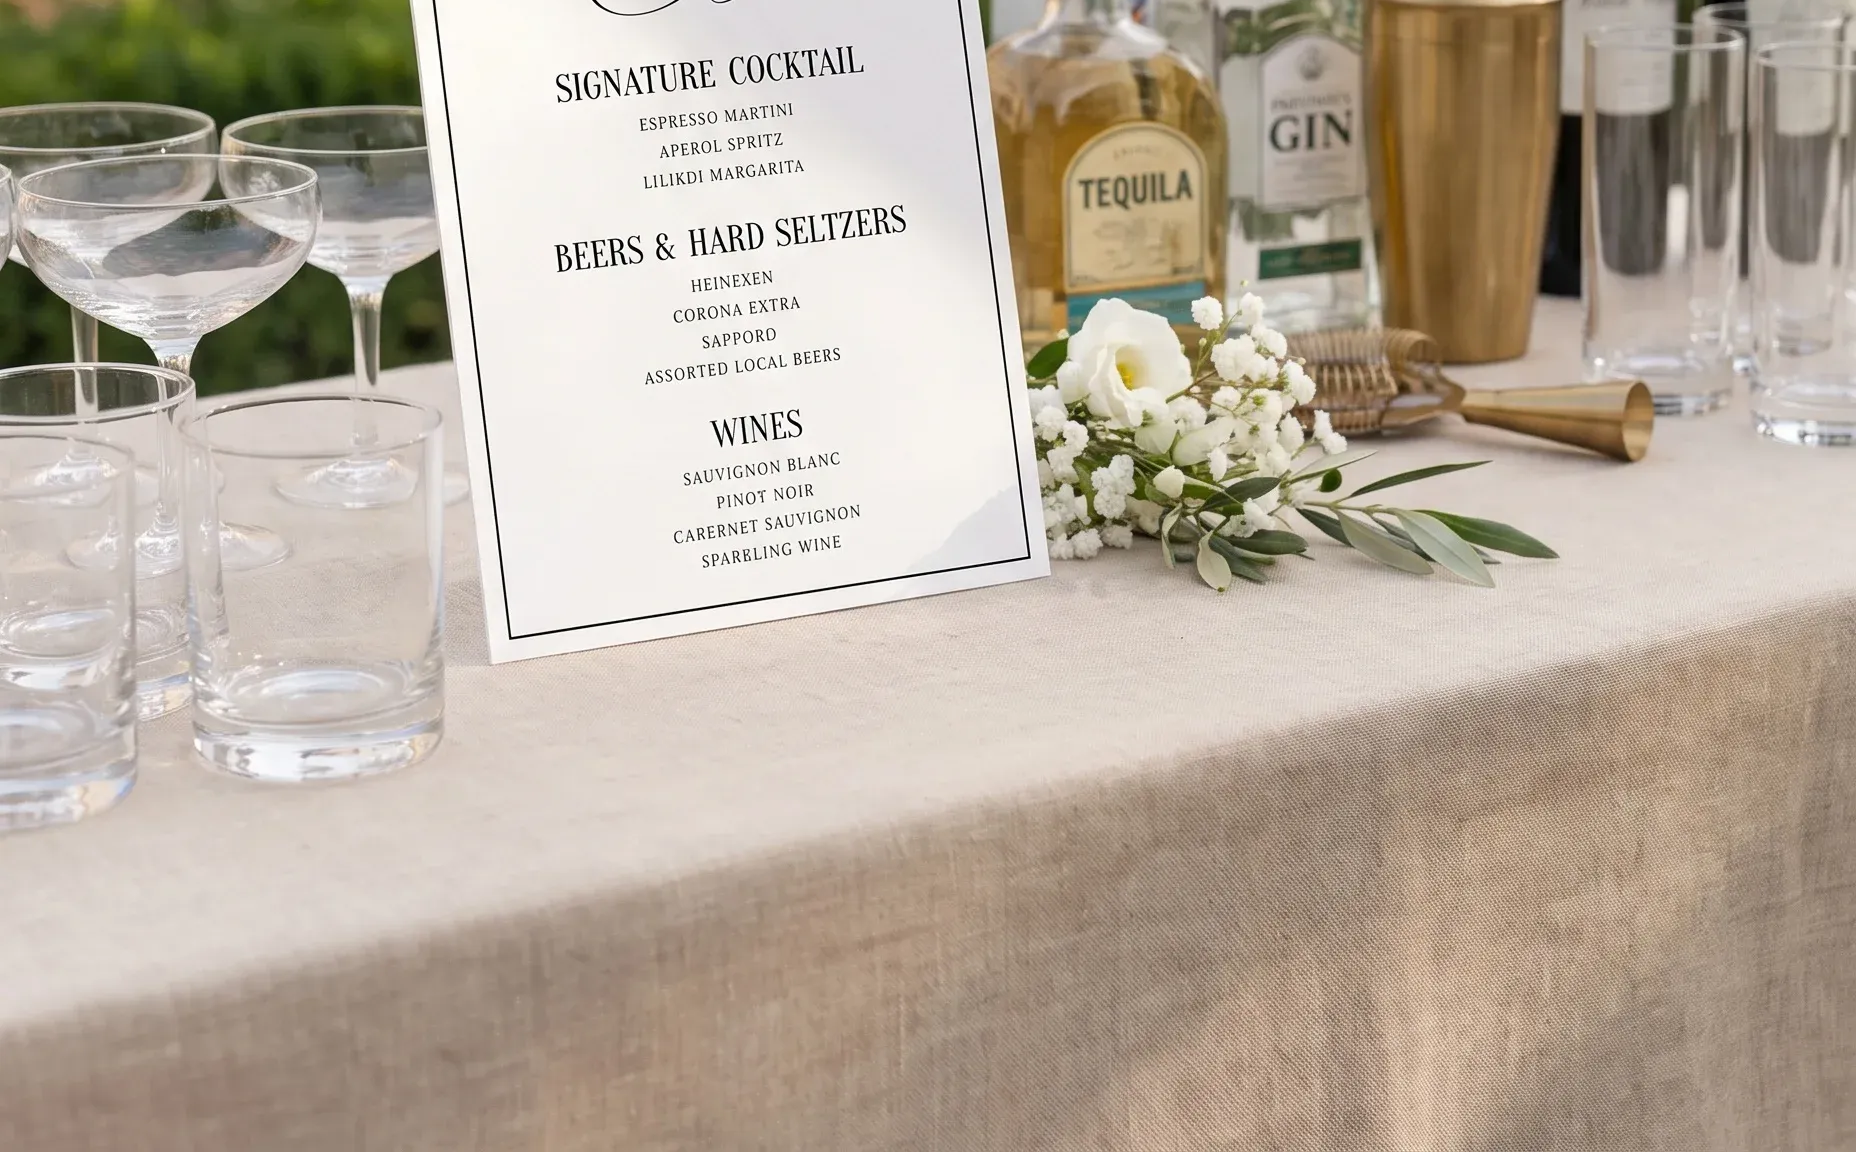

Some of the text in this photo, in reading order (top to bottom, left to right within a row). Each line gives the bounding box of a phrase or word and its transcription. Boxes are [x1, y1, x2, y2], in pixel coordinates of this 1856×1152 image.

[555, 45, 865, 103] SIGNATURE COCKTAIL
[639, 102, 793, 132] ESPRESSO MARTINI
[1269, 110, 1353, 152] GIN
[659, 132, 784, 159] APEROL SPRITZ
[709, 159, 805, 182] MARGARITA
[1079, 169, 1193, 210] TEQUILA
[553, 204, 907, 273] BEERS & HARD SELTZERS
[673, 296, 801, 324] CORONA EXTRA
[645, 347, 841, 385] ASSORTED LOCAL BEERS
[709, 408, 803, 448] WINES
[683, 451, 841, 486] SAUVIGNON BLANC
[716, 483, 814, 509] PINOT NOIR
[764, 504, 860, 531] SAUVIGNON
[798, 535, 842, 553] WINE
